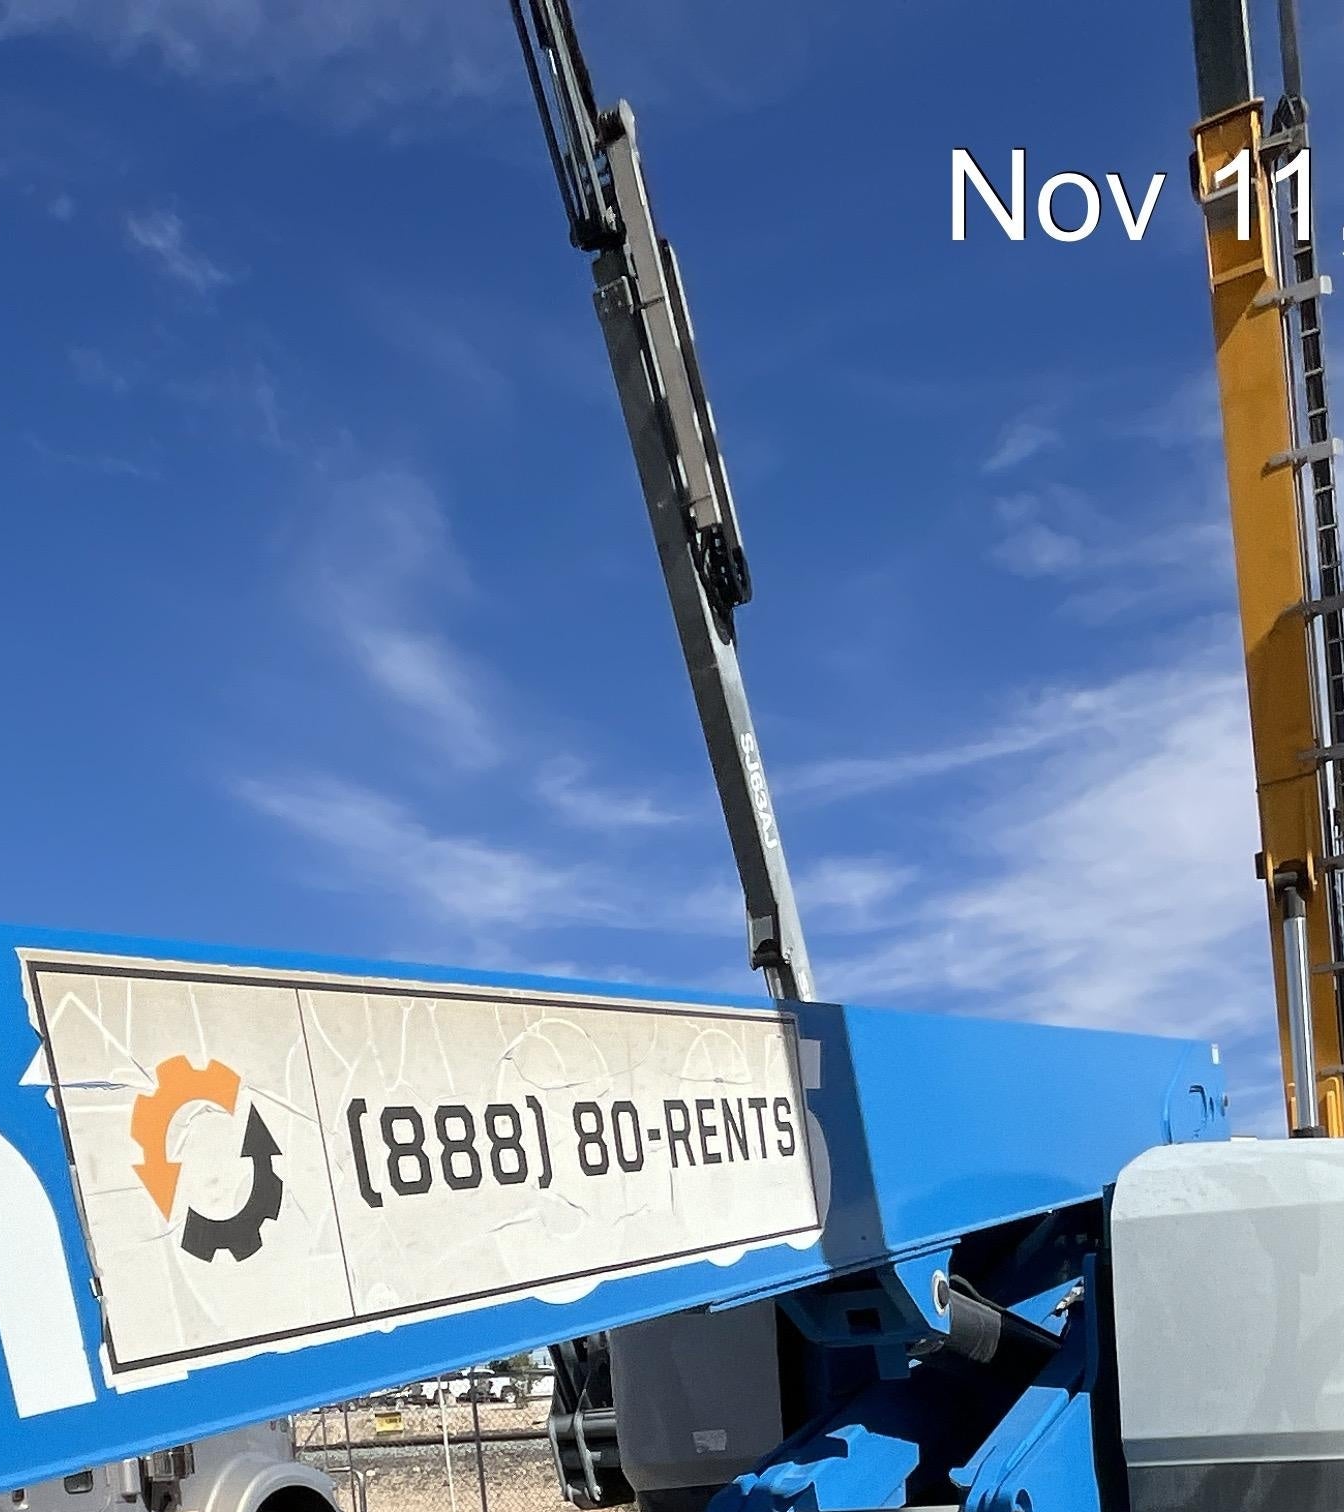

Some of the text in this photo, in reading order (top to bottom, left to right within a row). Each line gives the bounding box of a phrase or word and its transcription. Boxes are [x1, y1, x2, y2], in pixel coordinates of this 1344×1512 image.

[740, 732, 777, 849] SJ63AJ
[346, 1095, 796, 1208] (888) 80-RENTS
